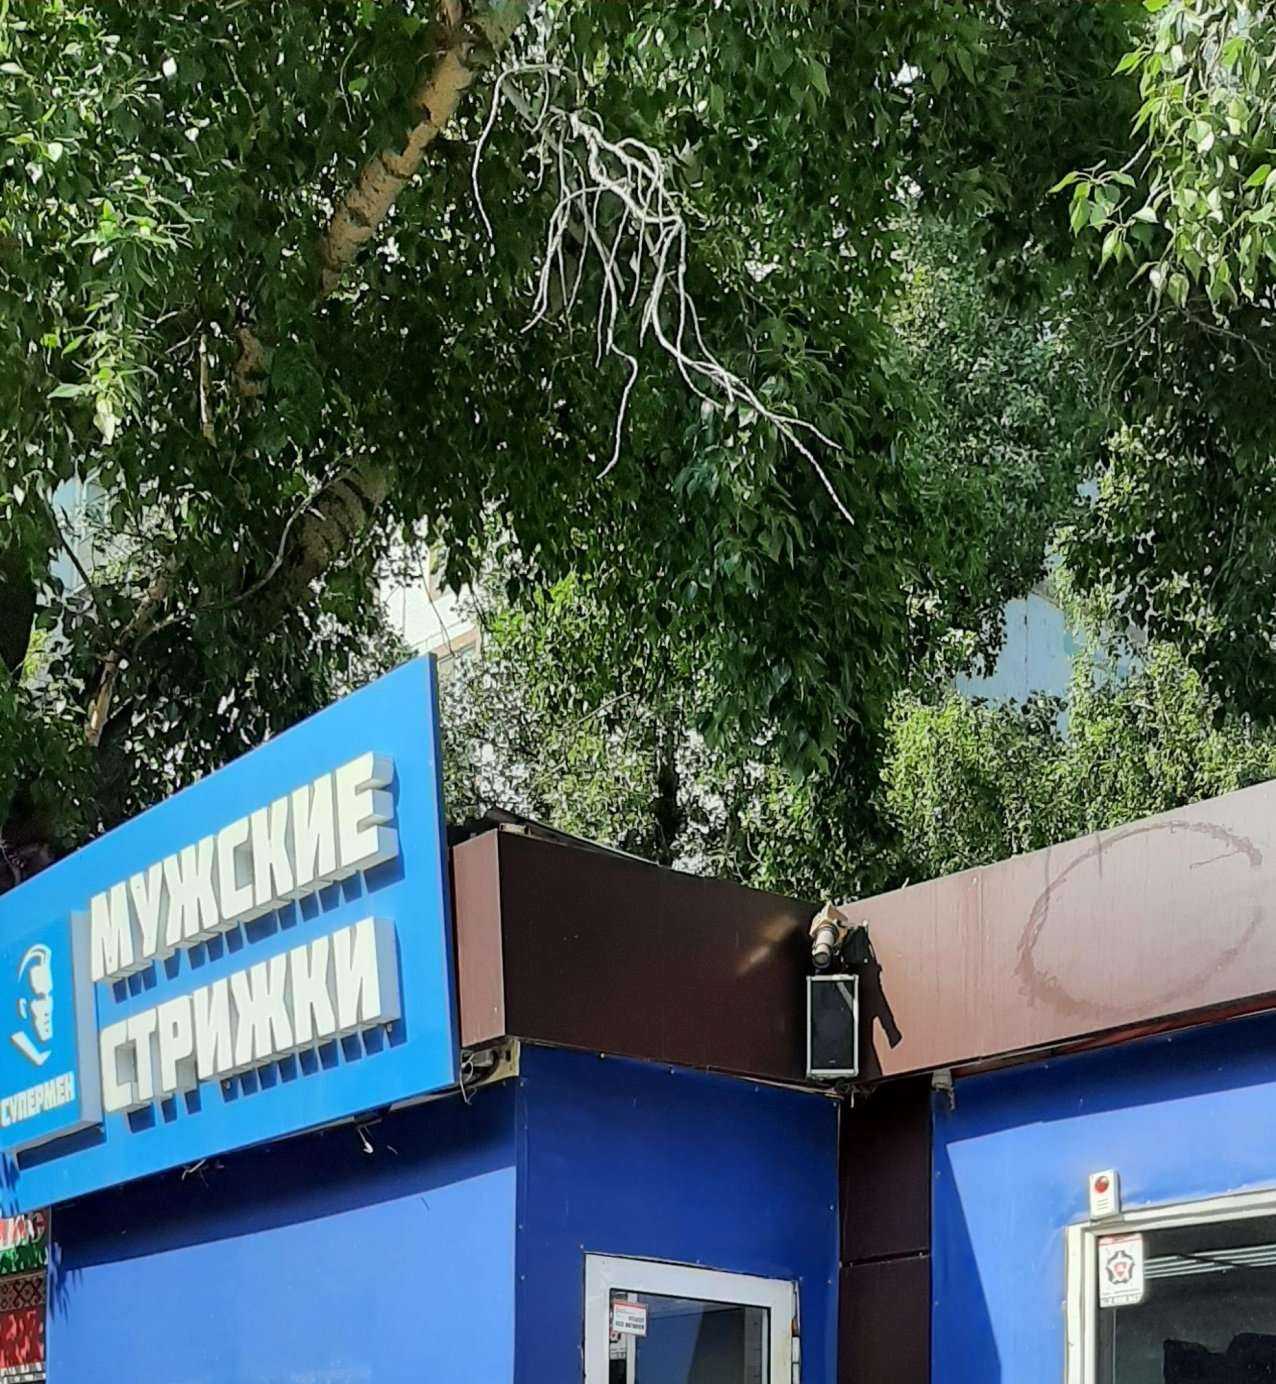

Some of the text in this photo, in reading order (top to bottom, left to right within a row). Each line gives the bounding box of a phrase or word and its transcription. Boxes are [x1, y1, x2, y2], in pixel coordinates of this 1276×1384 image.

[91, 752, 398, 982] МУЖСКИЕ
[0, 1070, 76, 1128] СУПЕРМЕН
[100, 917, 400, 1113] СТРИЖКИ
